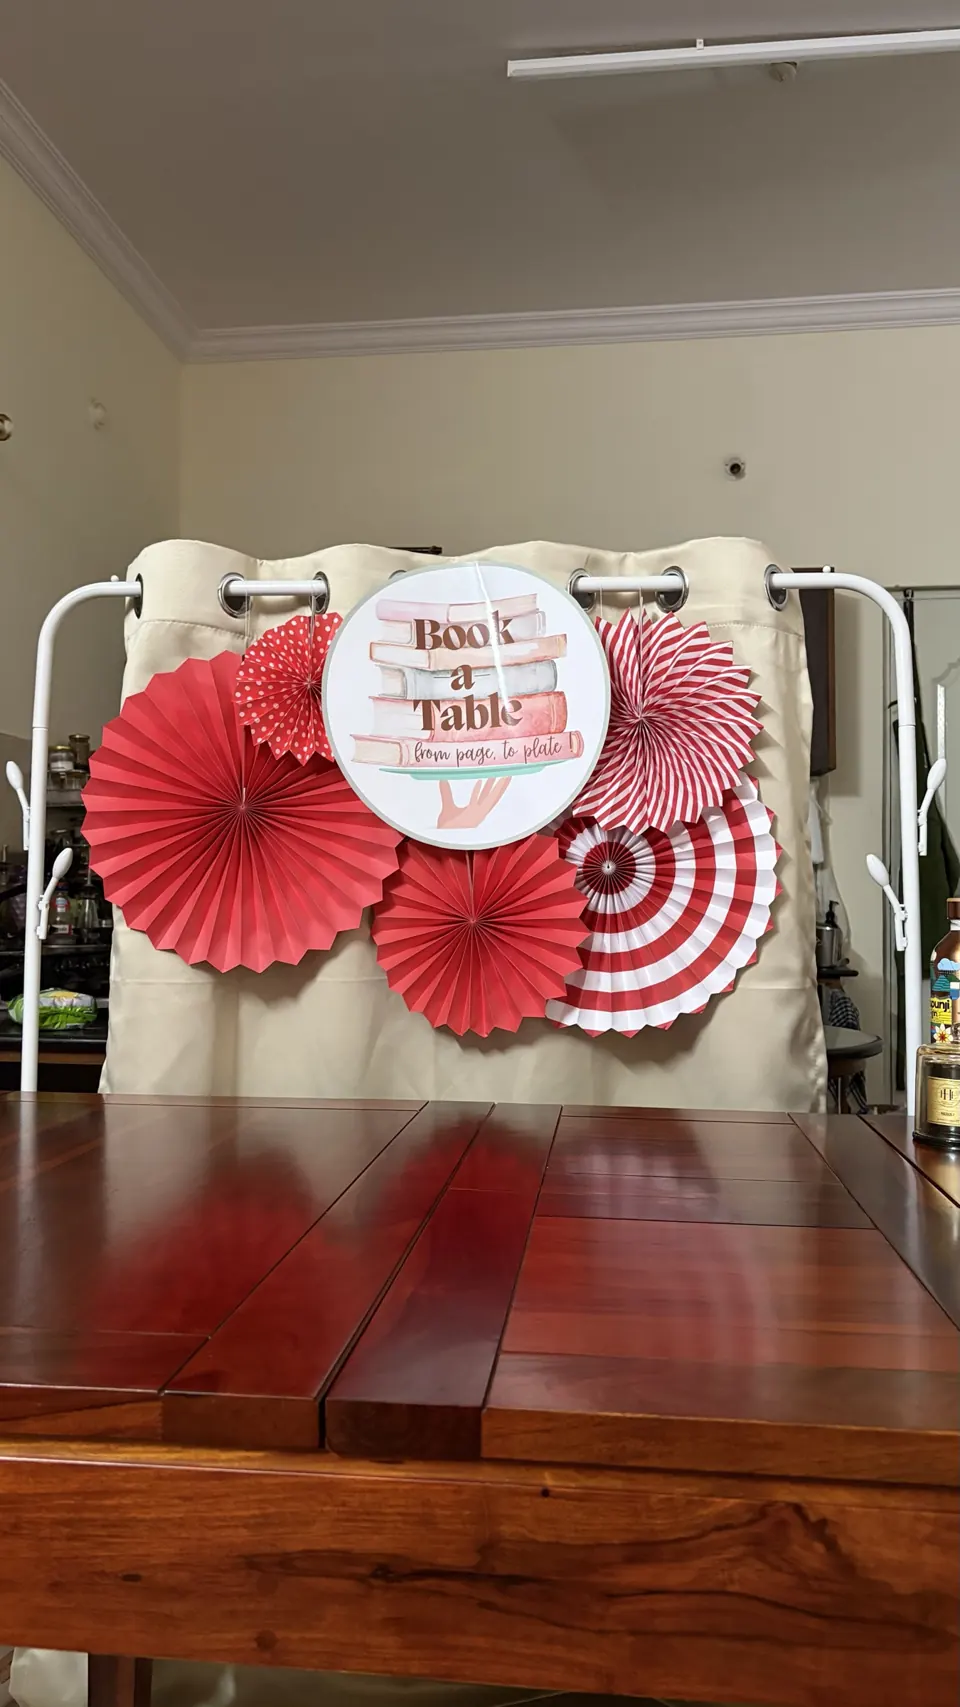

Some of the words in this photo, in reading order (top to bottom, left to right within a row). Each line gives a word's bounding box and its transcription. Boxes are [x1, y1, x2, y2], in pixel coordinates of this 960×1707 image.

[413, 610, 515, 650] Book
[450, 664, 476, 691] a
[413, 692, 523, 731] Table
[414, 741, 451, 763] from
[502, 740, 519, 760] to
[523, 736, 562, 764] plate
